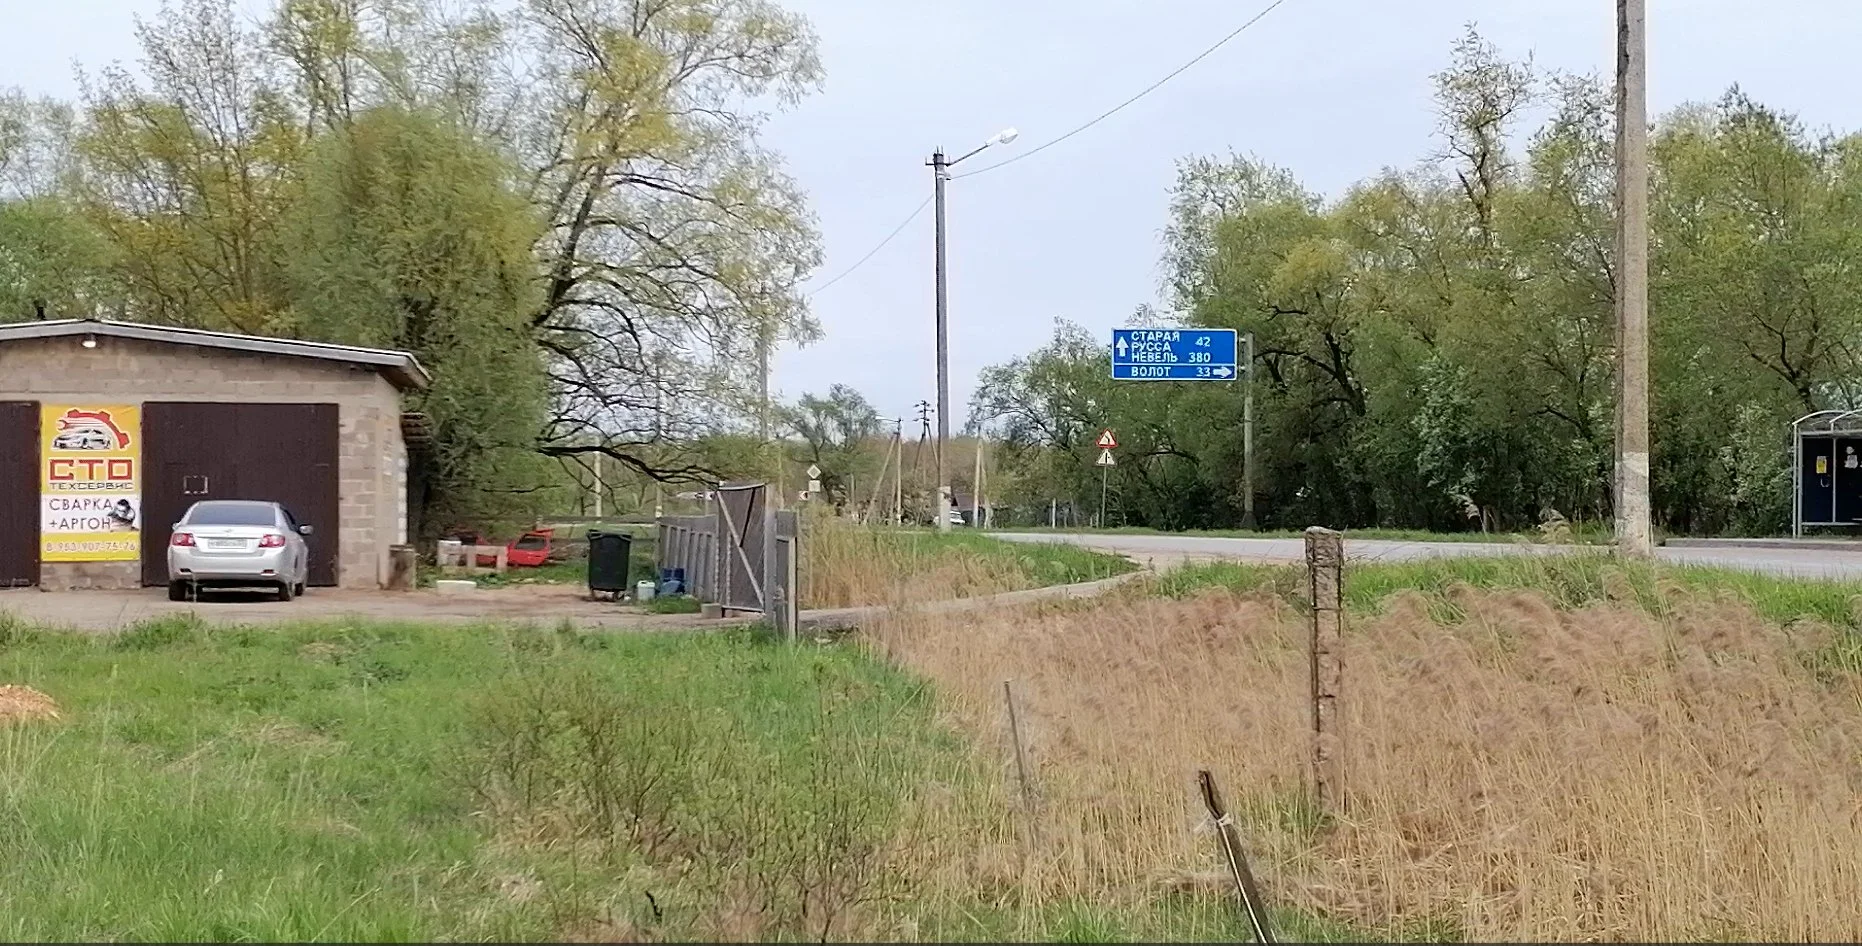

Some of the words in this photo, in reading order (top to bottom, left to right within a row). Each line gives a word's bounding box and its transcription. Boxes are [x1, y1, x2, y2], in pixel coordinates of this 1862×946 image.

[1131, 331, 1180, 342] СТАРАЯ
[1195, 336, 1211, 347] 42
[1131, 342, 1172, 352] РУССА
[1131, 352, 1178, 363] НЕВЕЛЬ
[1188, 352, 1211, 363] 380
[1131, 366, 1171, 377] ВОЛОТ
[1196, 366, 1211, 377] 33
[49, 459, 133, 481] СТО
[49, 482, 134, 490] ТЕХСЕРВИС
[49, 498, 113, 511] СВАРКА
[49, 517, 111, 530] +АРГОН
